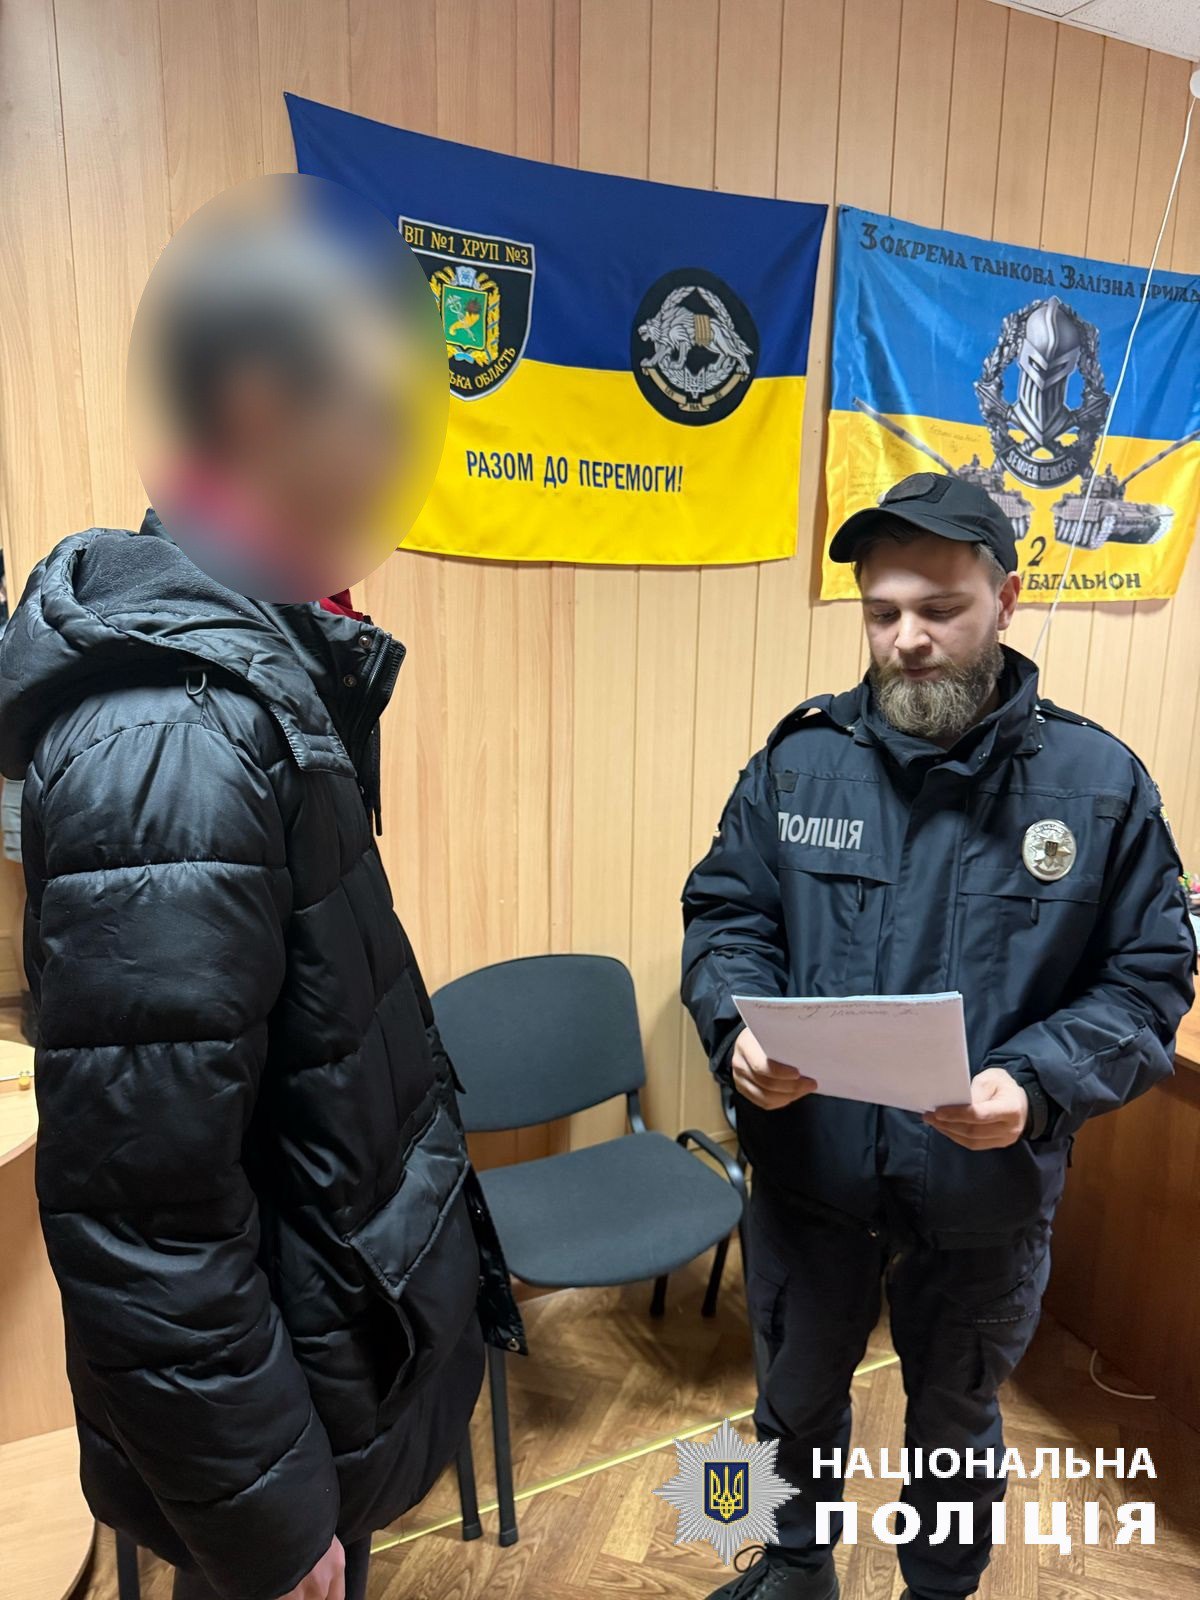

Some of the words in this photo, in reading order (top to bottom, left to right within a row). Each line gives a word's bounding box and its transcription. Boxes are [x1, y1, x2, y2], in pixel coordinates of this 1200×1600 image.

[404, 225, 424, 246] ВП
[431, 231, 455, 253] №1
[461, 238, 499, 261] ХРУП
[505, 249, 529, 266] №3
[474, 346, 516, 389] ОБЛАСТЬ
[466, 450, 534, 481] РАЗОМ
[543, 456, 568, 489] ДО
[579, 459, 683, 493] ПЕРЕМОГИ!
[1027, 535, 1047, 567] 2
[777, 811, 864, 850] ПОЛІЦІЯ
